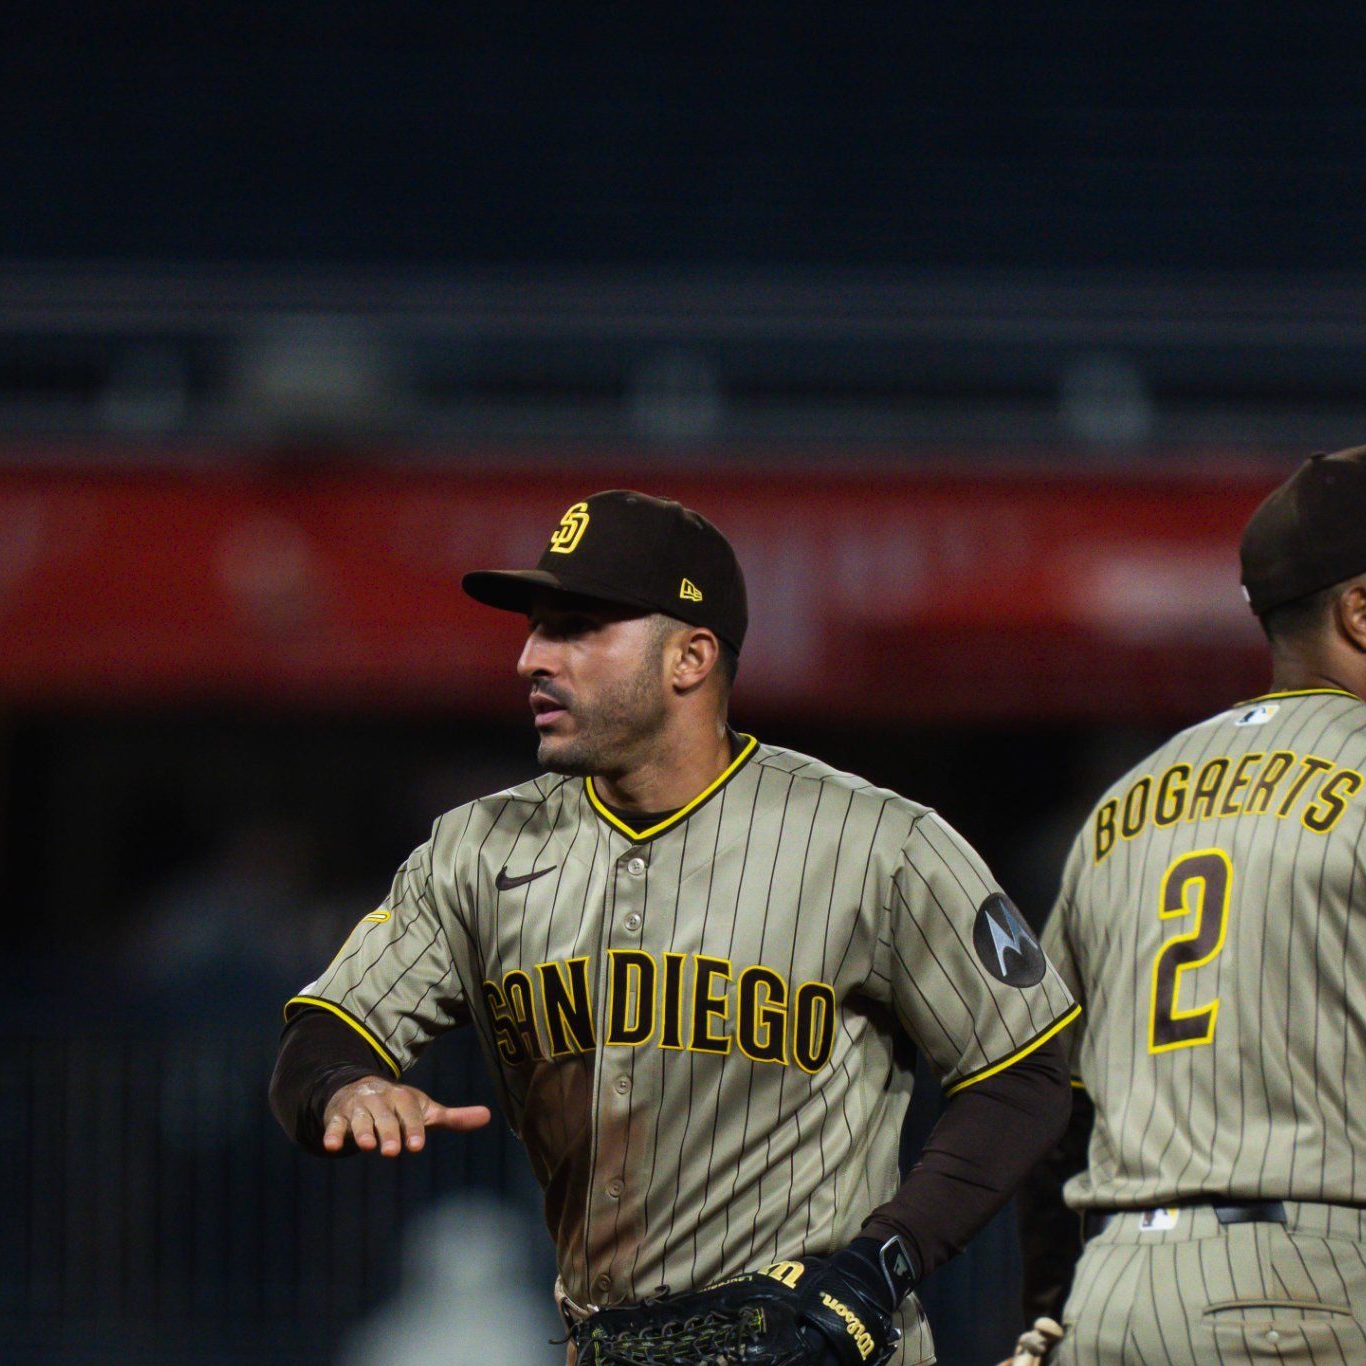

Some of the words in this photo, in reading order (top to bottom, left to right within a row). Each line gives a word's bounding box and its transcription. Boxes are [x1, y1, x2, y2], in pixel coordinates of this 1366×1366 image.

[550, 502, 590, 554] SD
[1093, 750, 1365, 866] BOGAERTS
[1148, 847, 1234, 1054] 2
[482, 958, 597, 1067] SAN
[605, 948, 836, 1076] DIEGO
[821, 1293, 875, 1361] Wilson
